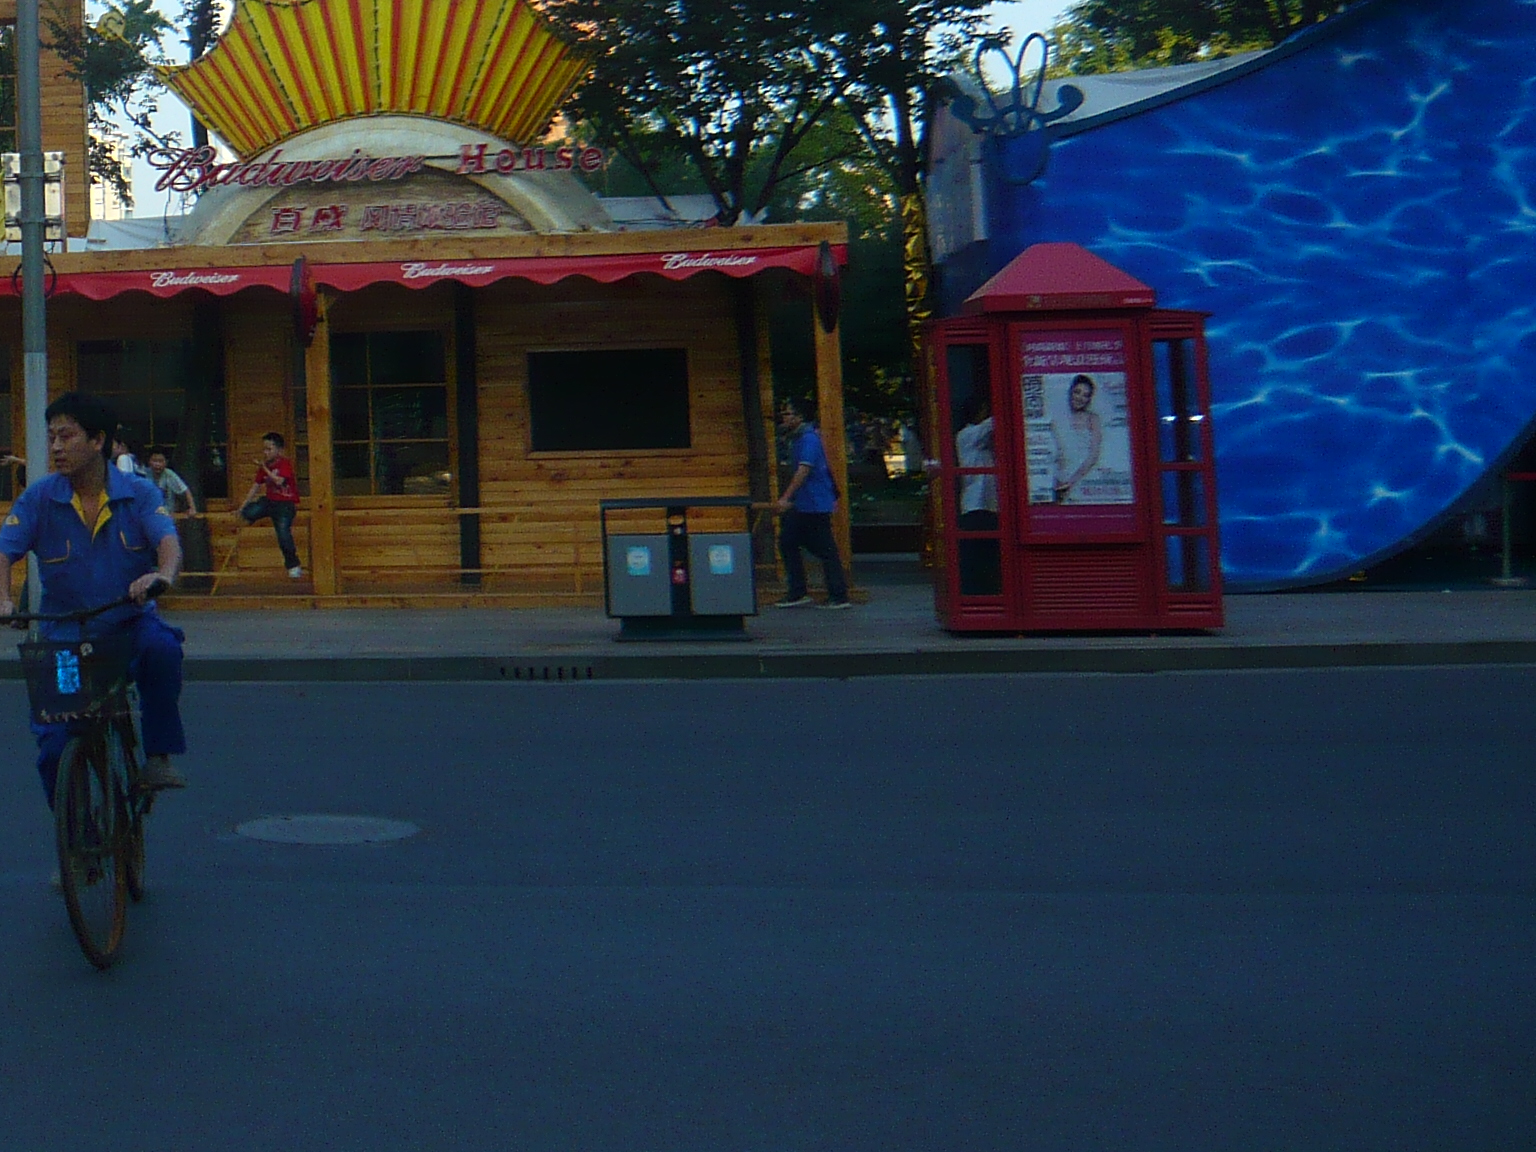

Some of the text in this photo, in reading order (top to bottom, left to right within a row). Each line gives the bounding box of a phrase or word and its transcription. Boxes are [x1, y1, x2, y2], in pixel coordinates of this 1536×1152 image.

[147, 143, 603, 193] Budweiser House
[270, 201, 349, 233] 百威
[401, 261, 494, 279] Budweiser
[661, 251, 757, 270] Budweiser
[151, 270, 239, 288] Budweiser
